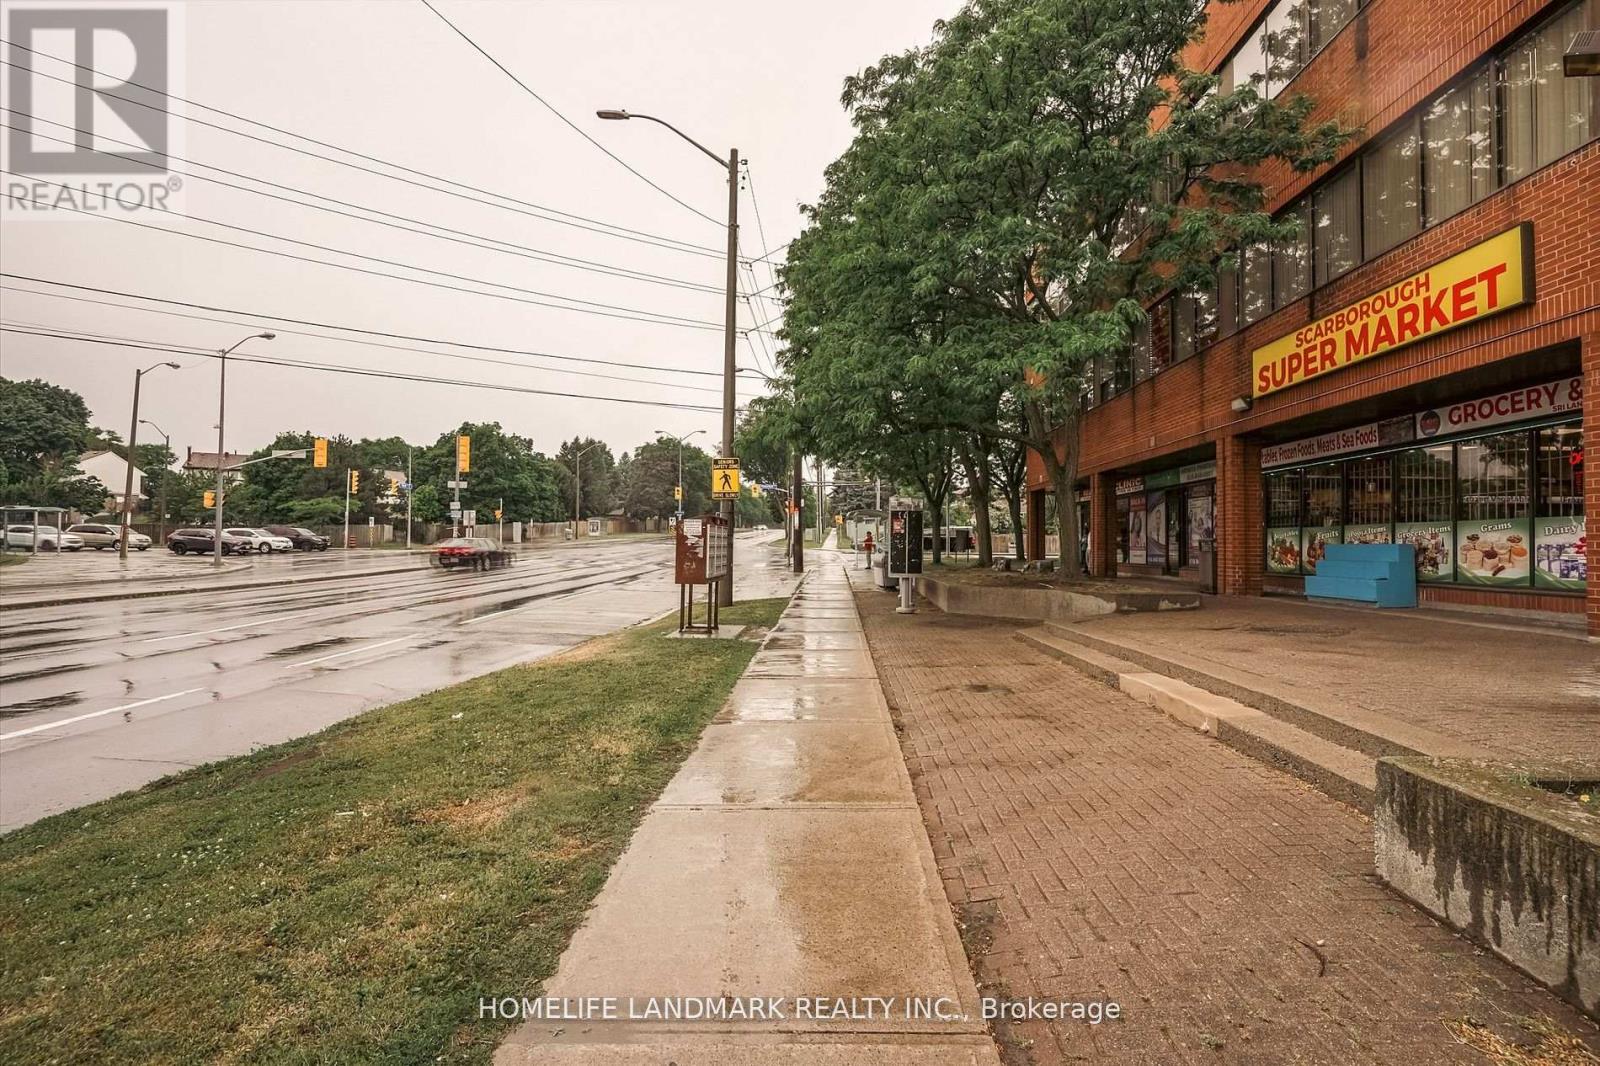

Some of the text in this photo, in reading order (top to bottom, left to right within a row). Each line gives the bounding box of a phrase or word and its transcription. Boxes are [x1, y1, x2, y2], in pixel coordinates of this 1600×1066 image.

[1295, 272, 1430, 348] SCARBOROUGH
[1257, 262, 1507, 393] SUPER MARKET
[1448, 383, 1560, 426] GROCERY
[1568, 378, 1583, 401] &
[1552, 404, 1566, 413] SRI
[1278, 447, 1297, 462] Frozen
[1317, 438, 1336, 453] Meats
[1336, 437, 1342, 450] &
[1342, 434, 1355, 448] Sea
[1355, 427, 1377, 446] Foods
[1397, 525, 1452, 540] Grocery Items
[1480, 521, 1512, 533] Grams
[1544, 523, 1578, 537] Dairy
[1316, 530, 1339, 540] Fruits
